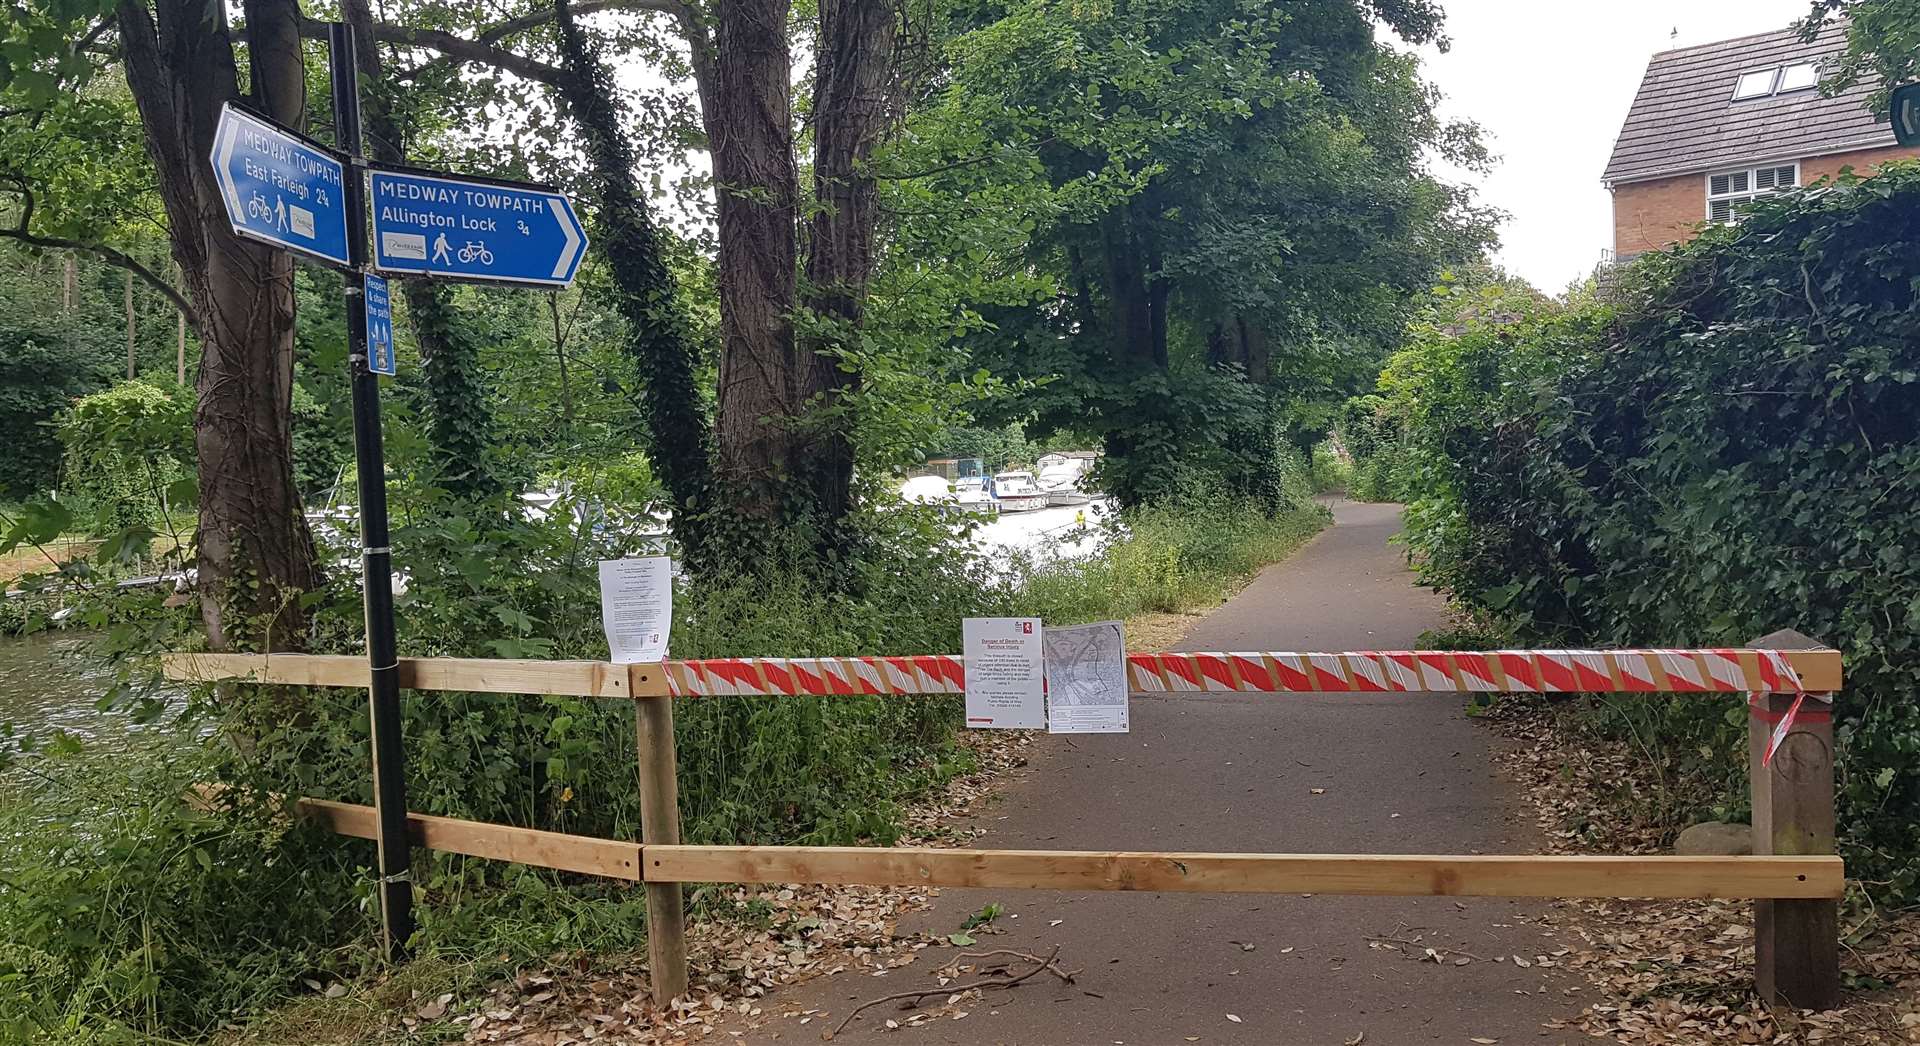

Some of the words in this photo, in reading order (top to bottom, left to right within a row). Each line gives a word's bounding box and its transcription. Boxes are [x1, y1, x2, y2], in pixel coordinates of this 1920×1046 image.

[244, 128, 292, 165] MEDWAY
[294, 151, 340, 187] TOWPATH
[245, 157, 269, 182] East
[271, 168, 309, 200] Farleigh
[380, 181, 459, 204] MEDWAY
[464, 191, 543, 214] TOWPATH
[382, 206, 455, 228] Allington
[462, 214, 496, 232] Lock
[367, 277, 387, 292] Respect
[368, 303, 377, 316] the
[377, 308, 389, 319] path
